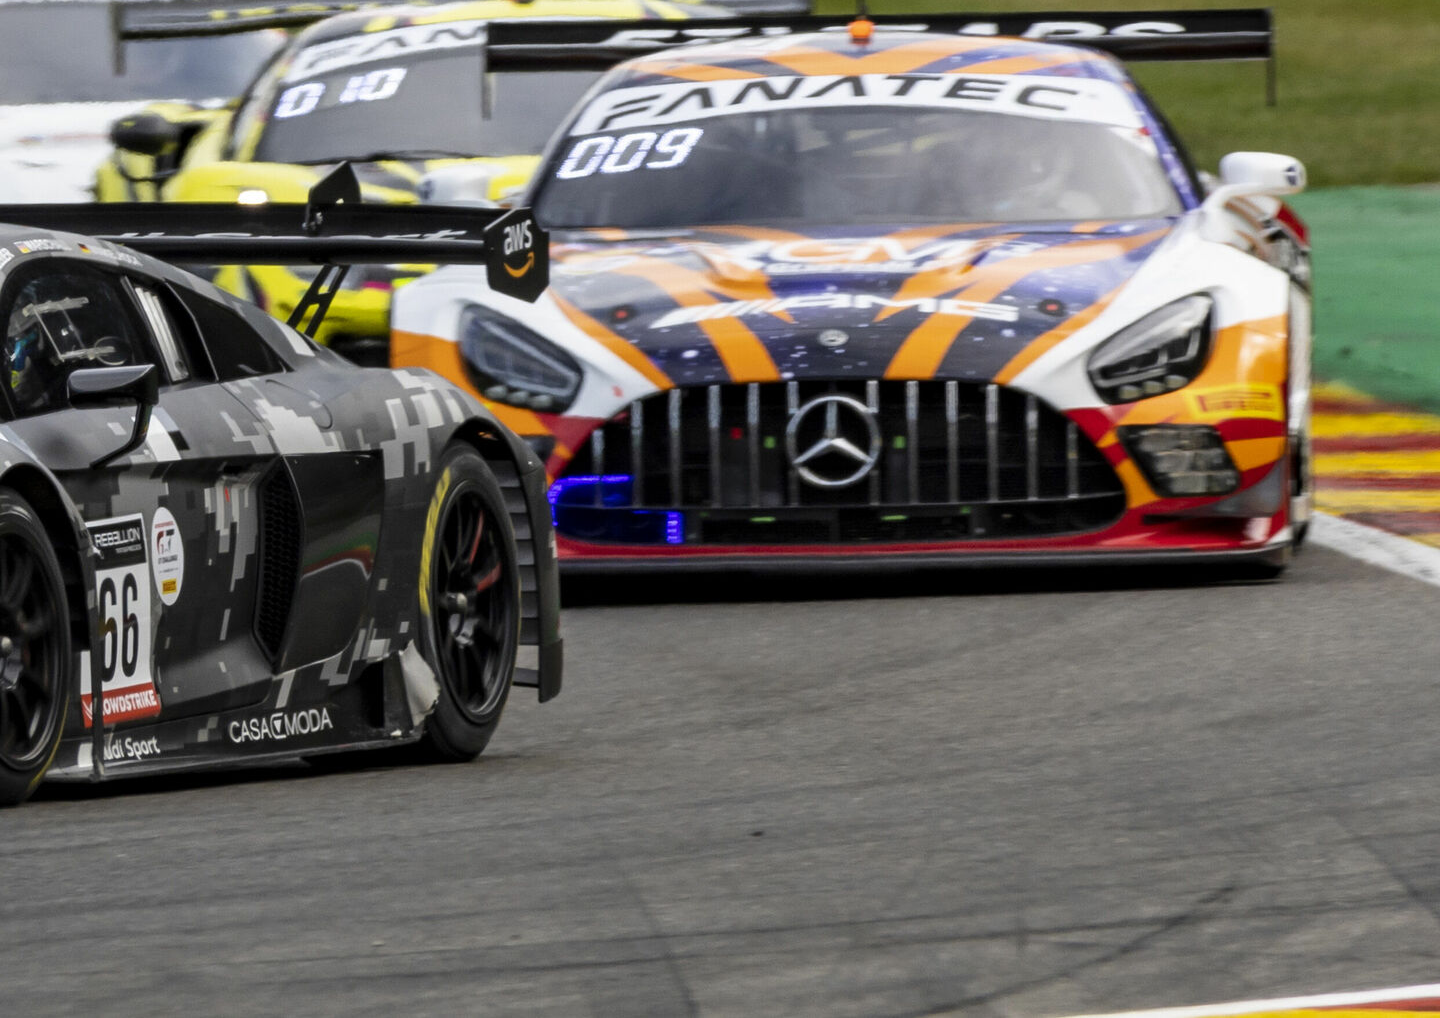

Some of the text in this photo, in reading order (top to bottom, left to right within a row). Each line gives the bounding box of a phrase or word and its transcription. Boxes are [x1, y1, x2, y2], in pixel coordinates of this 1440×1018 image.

[601, 75, 1078, 129] FANATEC
[556, 128, 704, 179] 009
[503, 219, 533, 255] aws
[769, 294, 1019, 322] AMG
[94, 527, 141, 548] REBELLION
[100, 572, 139, 682] 66
[90, 690, 158, 717] OWDSTRIKE
[125, 736, 161, 760] Sport
